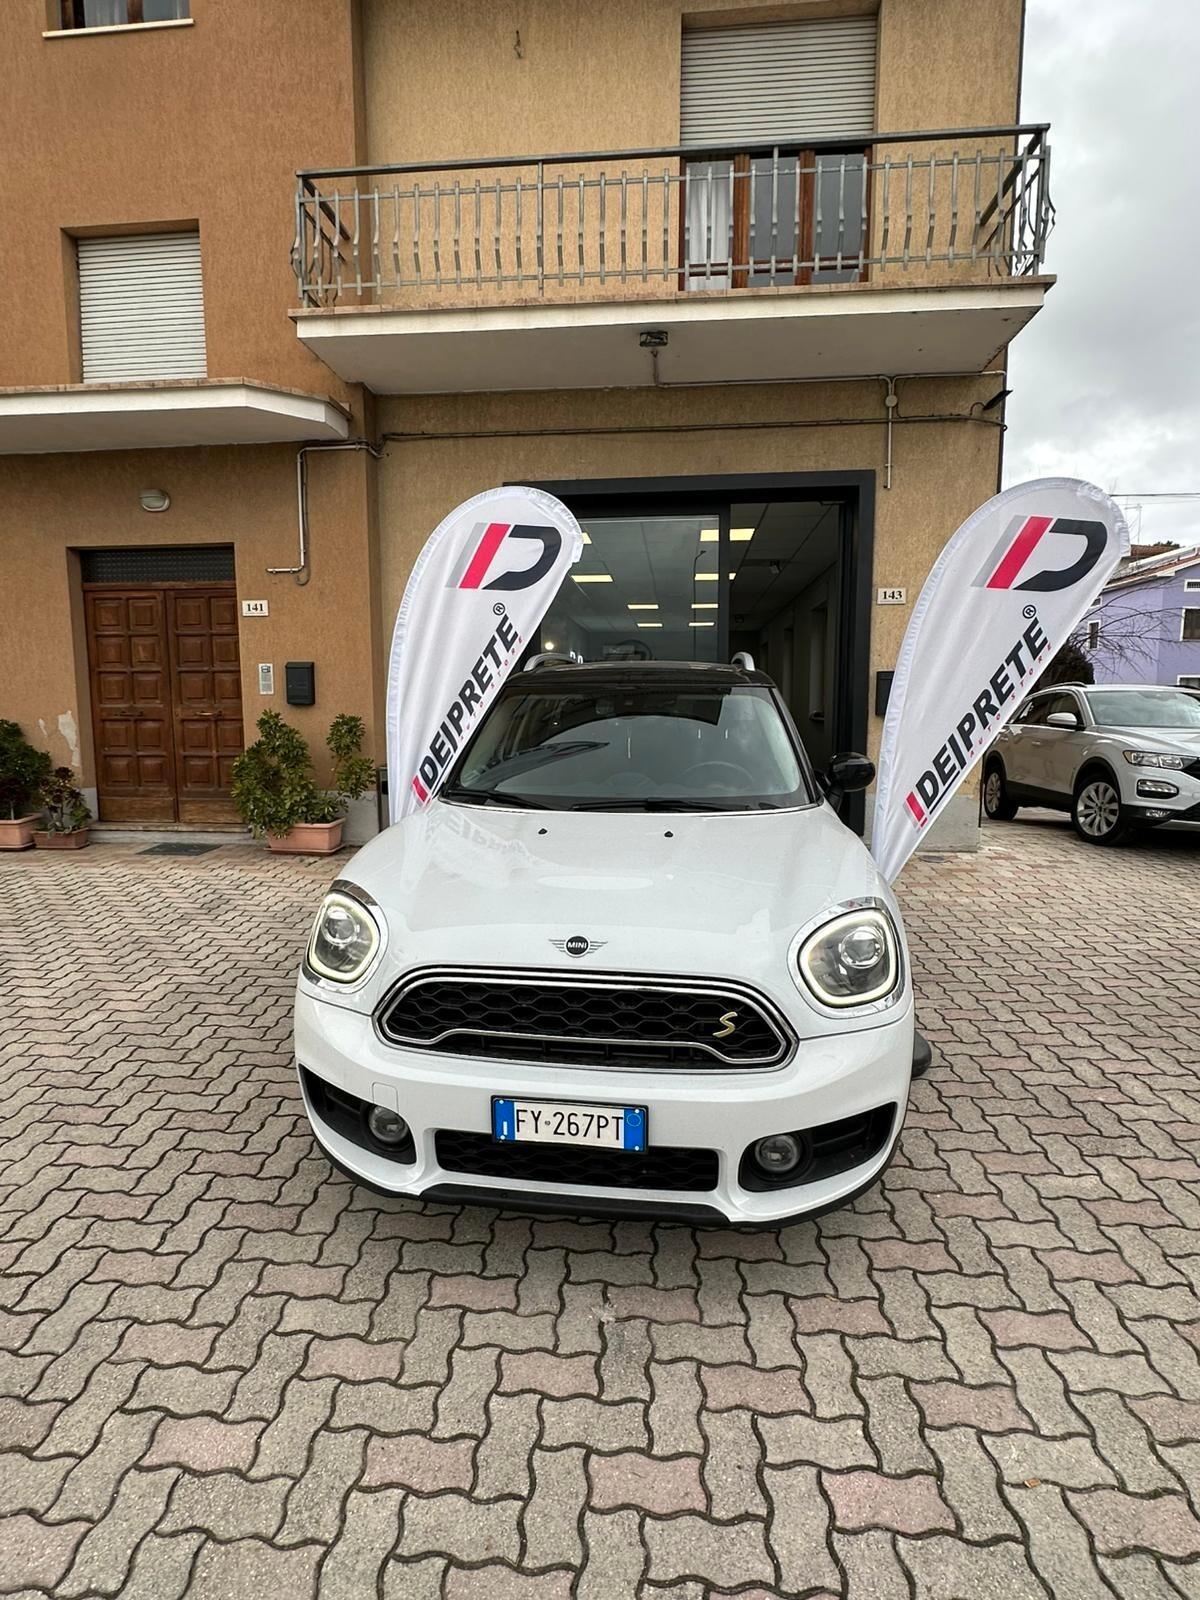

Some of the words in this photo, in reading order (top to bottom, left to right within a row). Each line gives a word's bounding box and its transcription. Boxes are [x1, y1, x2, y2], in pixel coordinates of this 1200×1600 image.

[882, 590, 903, 600] 143
[247, 603, 264, 612] 141
[1010, 642, 1052, 701] STORE
[567, 941, 588, 950] MINI
[712, 1011, 738, 1038] S
